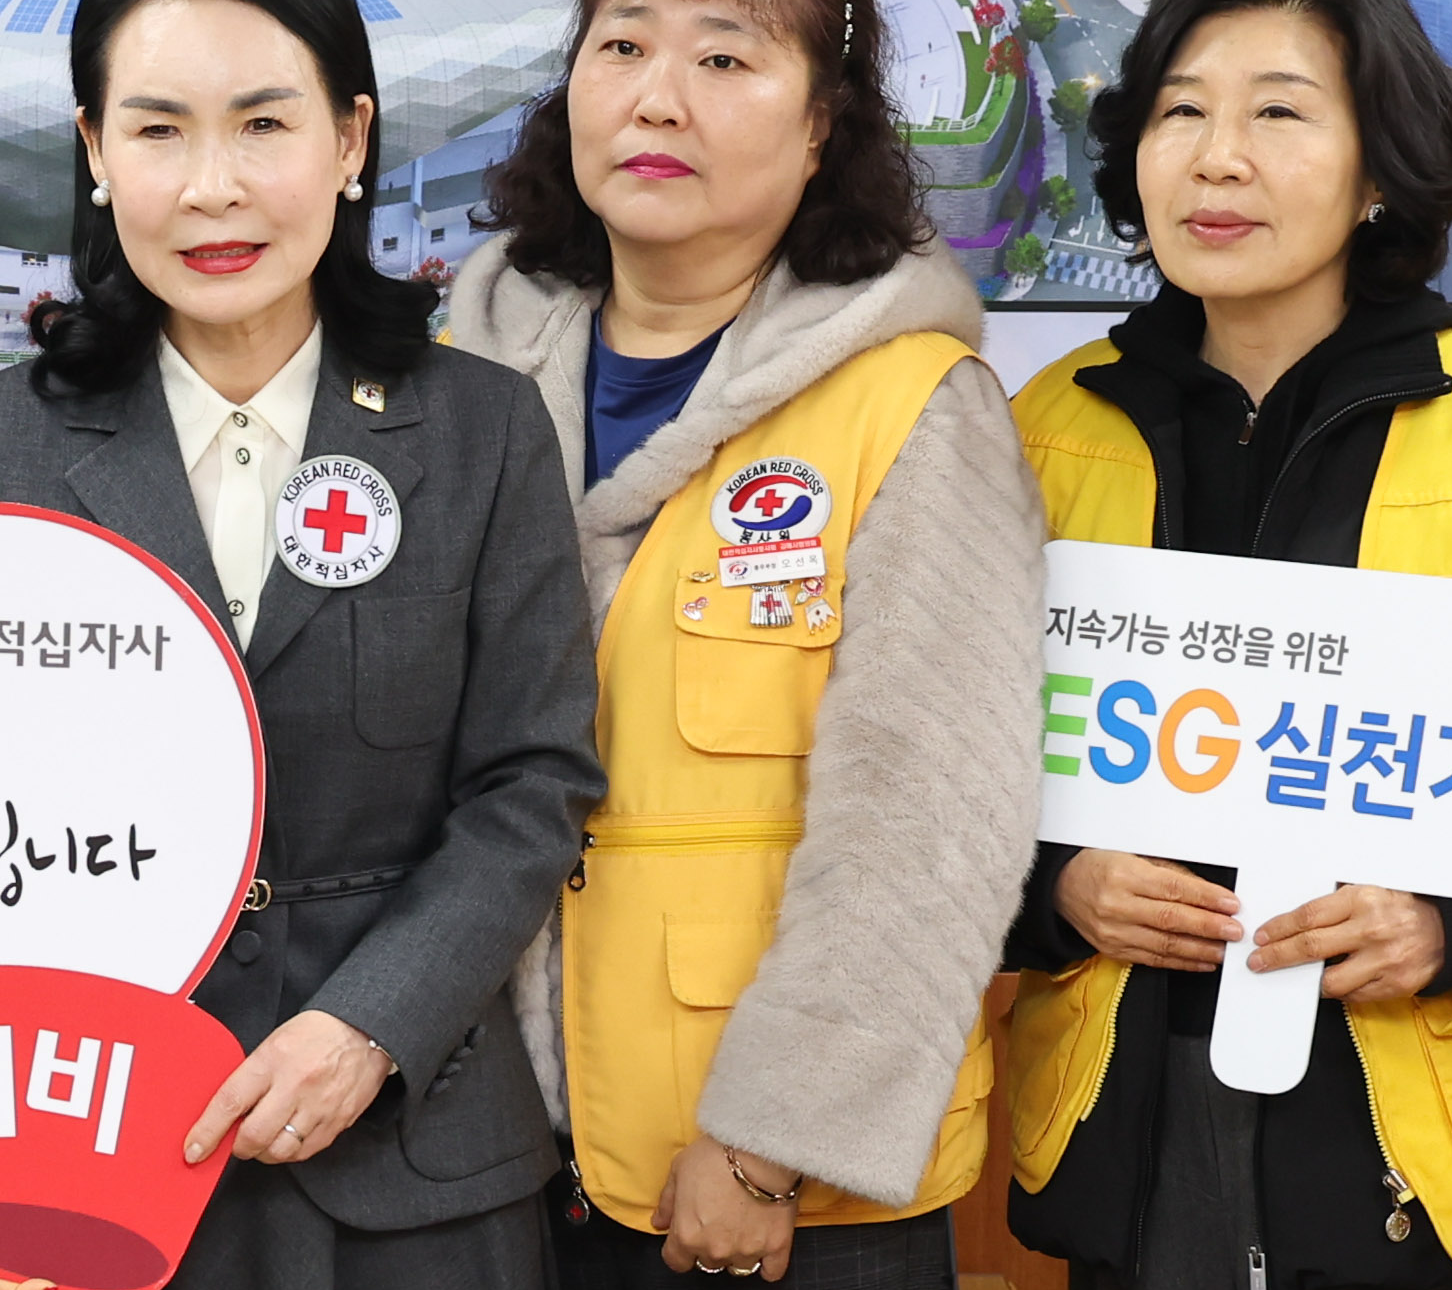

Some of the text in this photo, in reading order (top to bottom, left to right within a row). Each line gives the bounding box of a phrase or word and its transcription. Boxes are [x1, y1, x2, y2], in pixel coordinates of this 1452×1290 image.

[282, 462, 393, 517] KOREAN RED CROSS
[726, 462, 823, 496] KOREAN RED CROSS
[283, 535, 384, 580] 대한적십자사
[1045, 605, 1349, 676] 지속가능 성장을 위한
[1041, 671, 1242, 794] ESG
